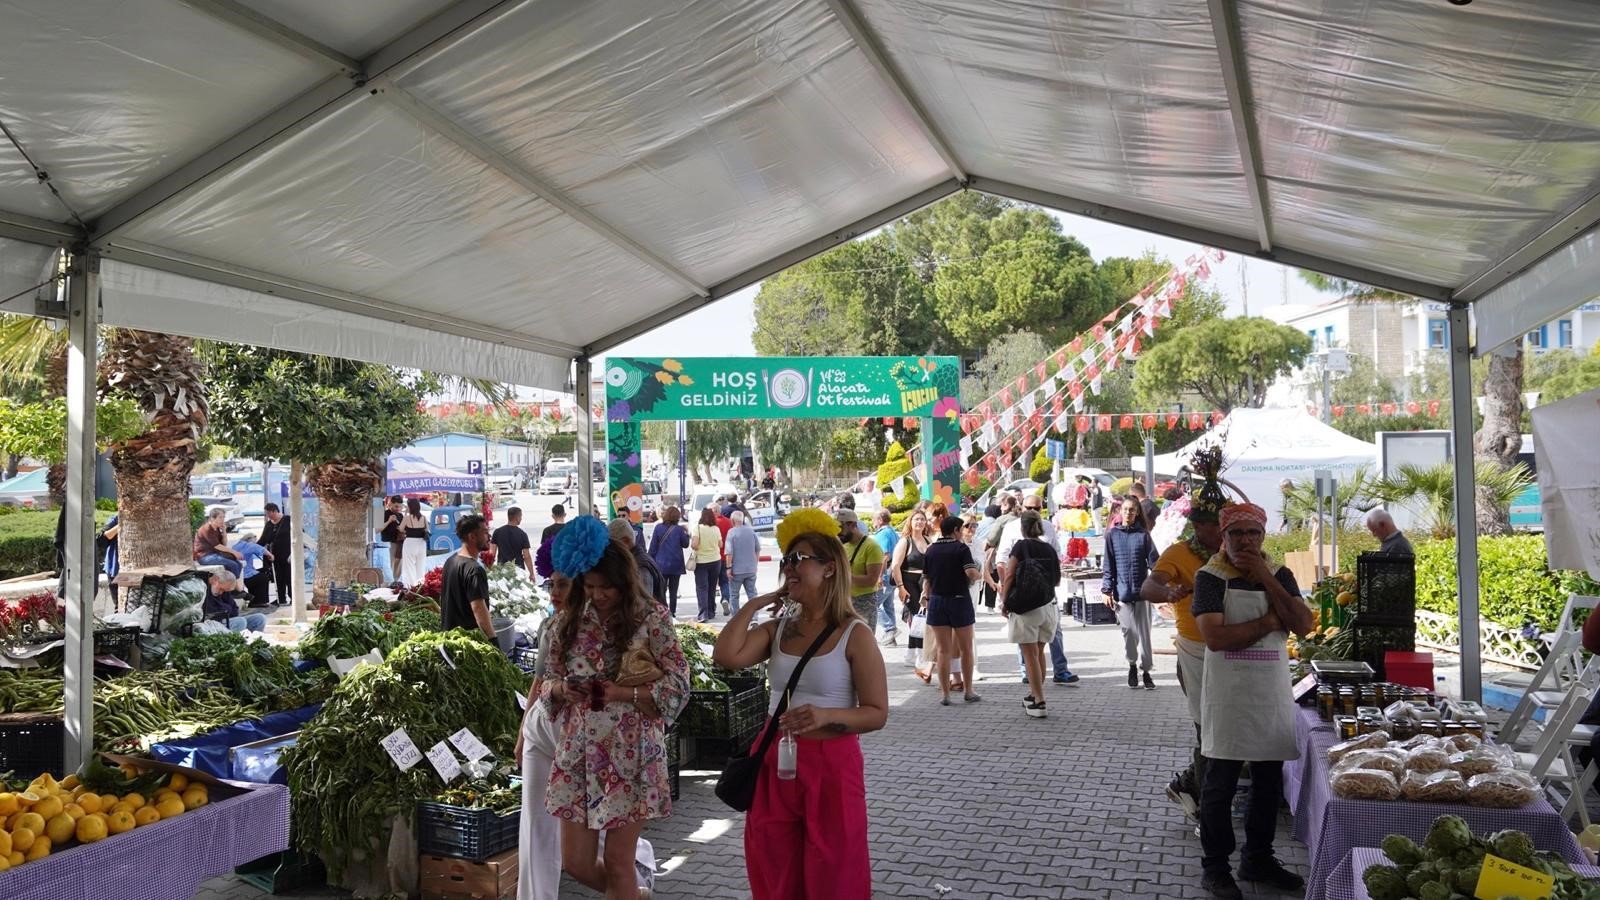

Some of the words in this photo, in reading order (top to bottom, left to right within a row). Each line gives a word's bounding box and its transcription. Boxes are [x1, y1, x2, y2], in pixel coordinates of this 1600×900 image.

[712, 372, 757, 390] HOŞ
[818, 382, 870, 394] Alaçatı
[680, 391, 758, 406] GELDİNİZ
[817, 394, 835, 405] Ot
[836, 392, 891, 405] Festivali
[470, 462, 479, 473] P
[1241, 465, 1273, 473] DANIŞMA
[1275, 464, 1305, 472] NOKTASI
[399, 478, 432, 490] ALAÇATI
[1488, 859, 1496, 868] 3
